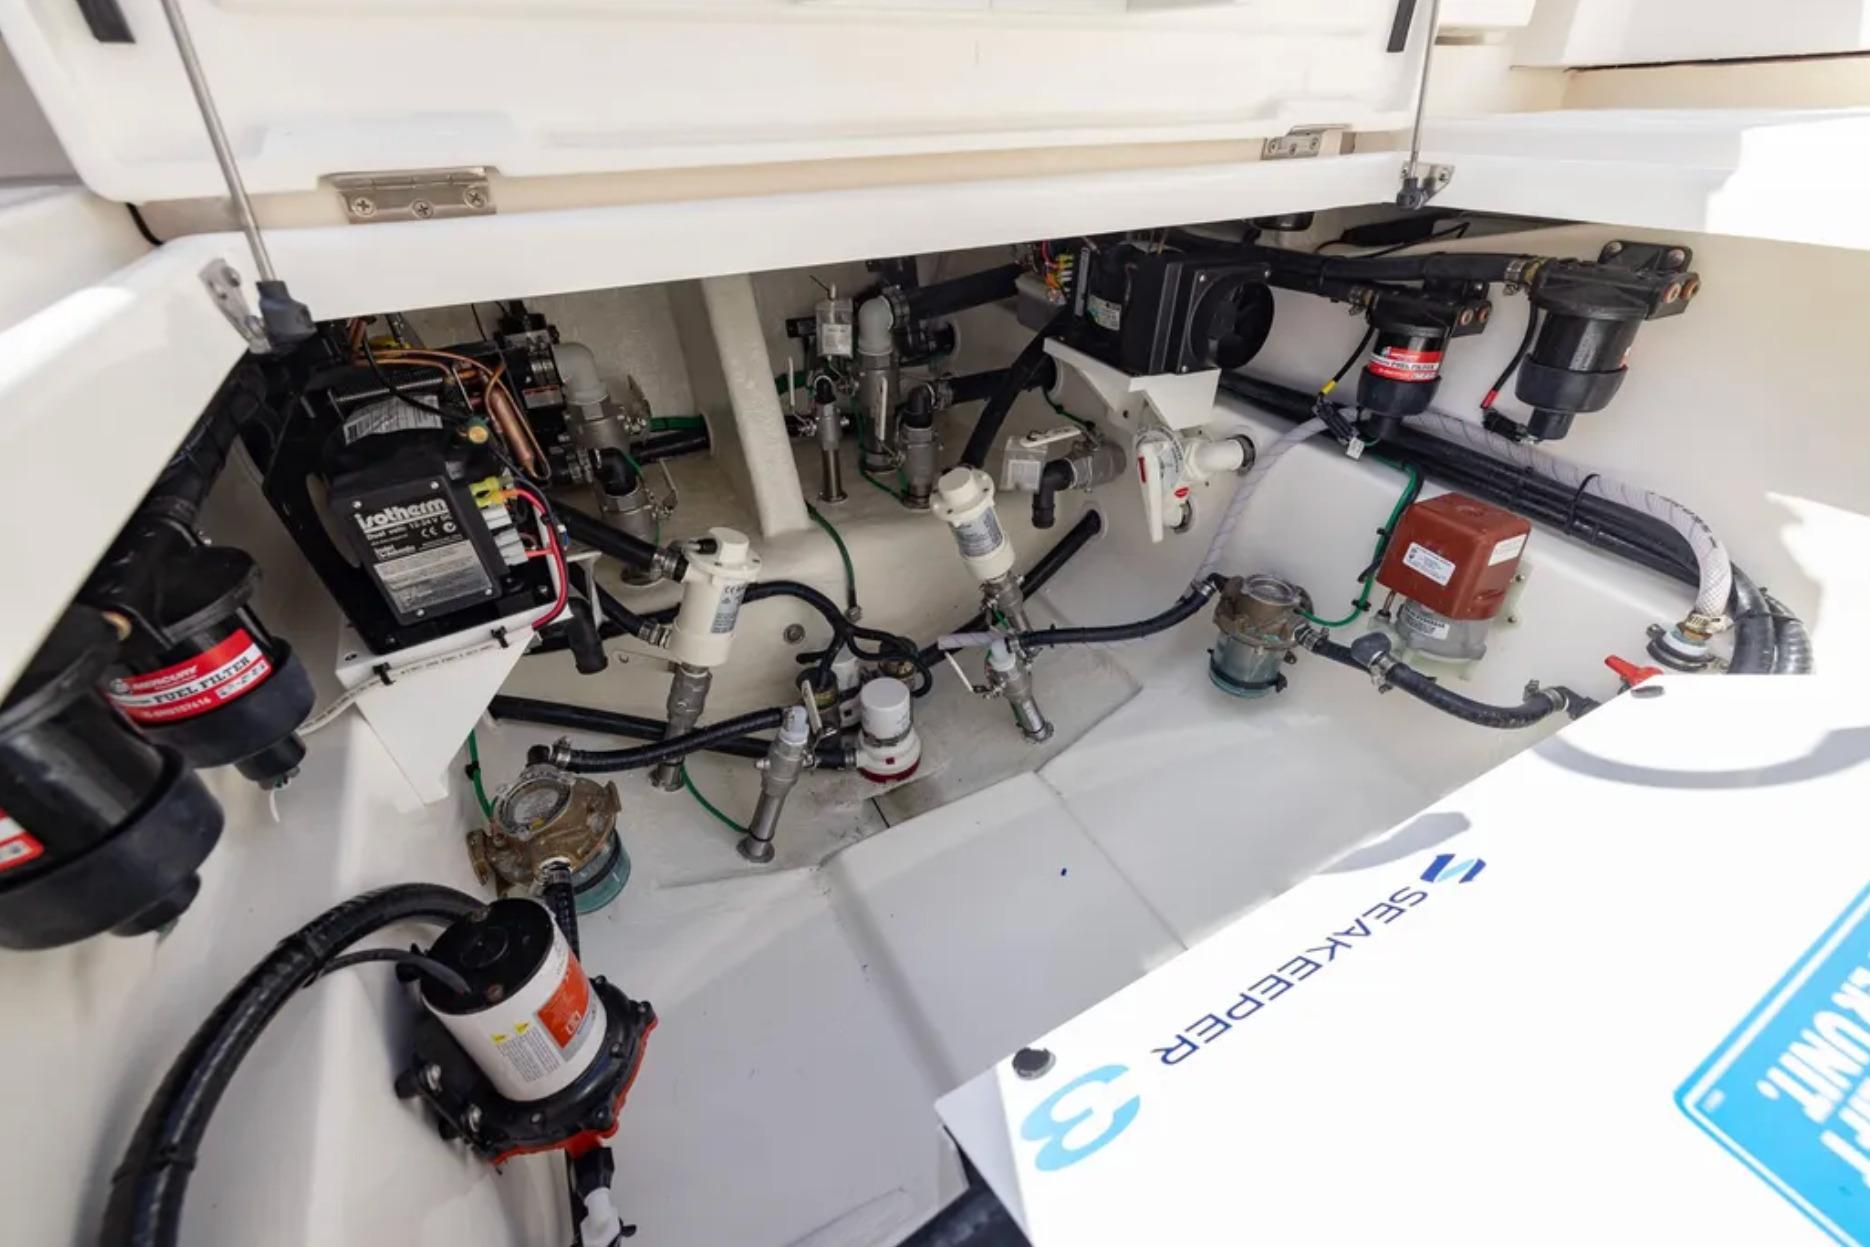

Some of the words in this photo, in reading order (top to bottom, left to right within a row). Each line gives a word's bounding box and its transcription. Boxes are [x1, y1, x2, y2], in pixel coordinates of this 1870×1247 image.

[354, 498, 449, 529] isotherm
[132, 665, 198, 689] MERCURY
[154, 687, 198, 703] FUEL
[200, 656, 250, 689] FILTER
[1151, 887, 1428, 1065] SEAKEEPER
[1756, 1010, 1870, 1125] UNIT.
[1020, 1064, 1141, 1172] 3
